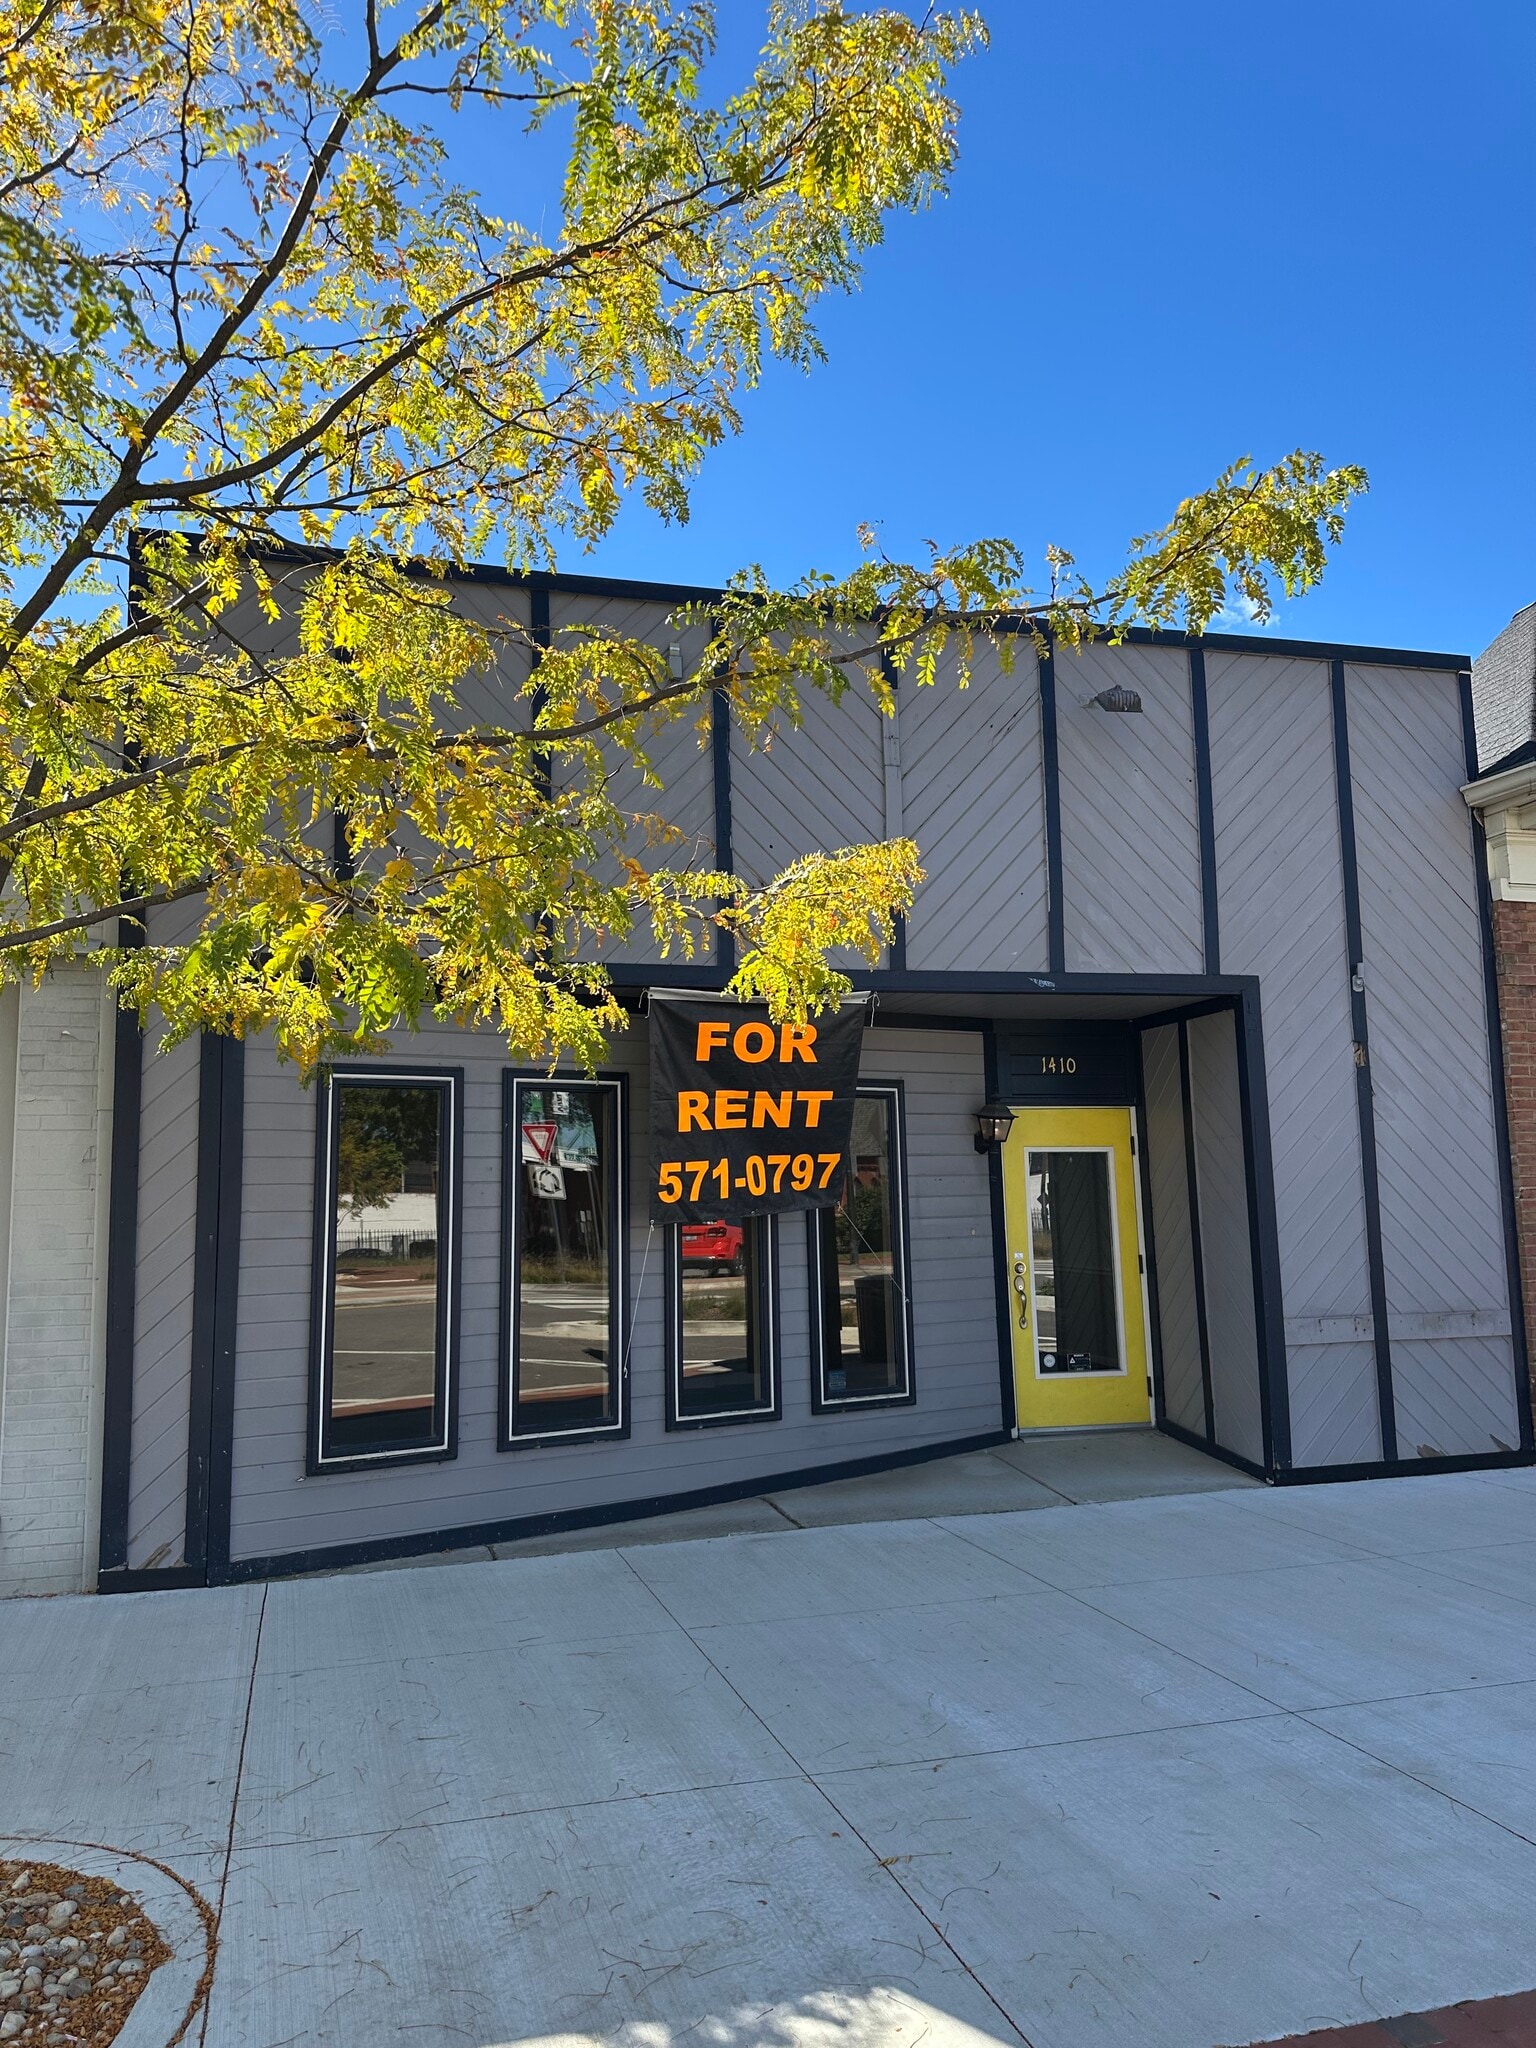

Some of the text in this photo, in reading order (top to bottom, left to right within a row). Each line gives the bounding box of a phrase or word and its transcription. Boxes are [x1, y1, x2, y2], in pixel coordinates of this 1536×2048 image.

[695, 1021, 818, 1064] FOR
[1041, 1056, 1077, 1074] 1410
[677, 1089, 834, 1133] RENT
[657, 1152, 842, 1204] 571-0797
